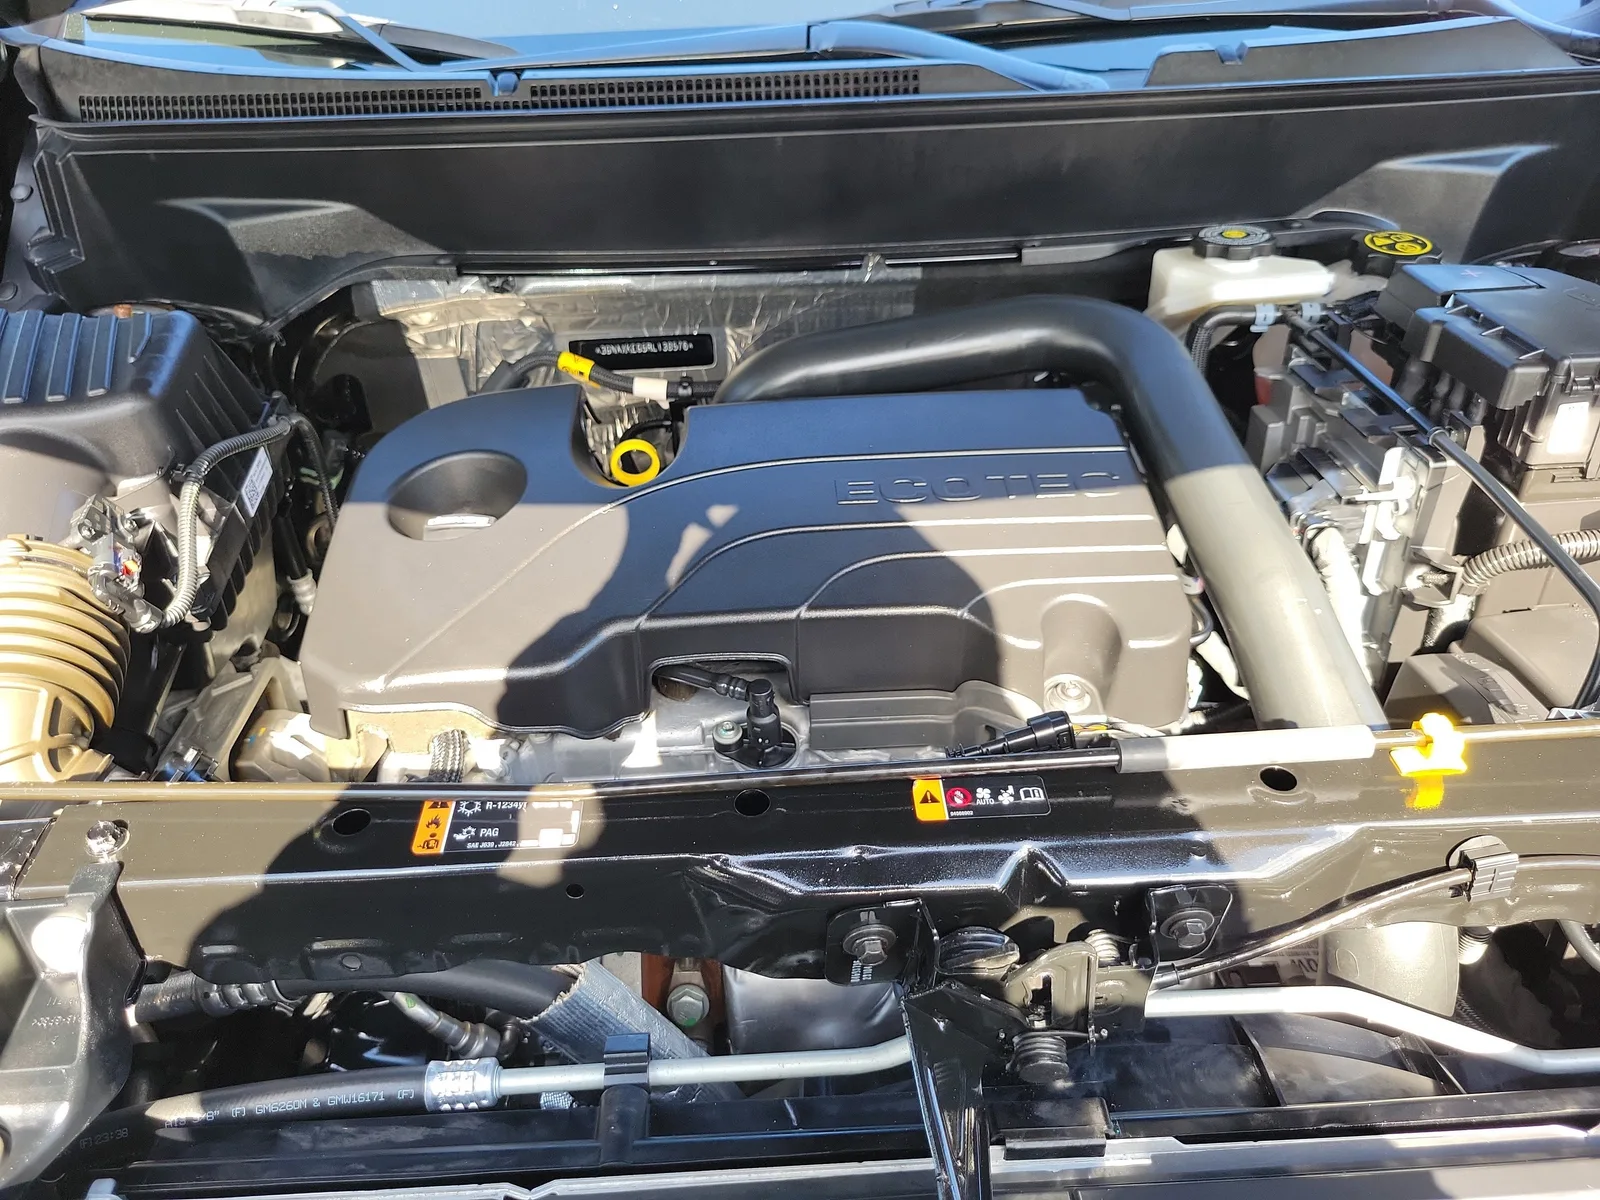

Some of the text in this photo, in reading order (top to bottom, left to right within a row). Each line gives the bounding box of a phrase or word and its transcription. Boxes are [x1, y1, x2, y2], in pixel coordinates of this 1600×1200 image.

[834, 473, 1120, 505] ECOTEC
[479, 828, 499, 837] PAG
[255, 1099, 307, 1115] GM6260M
[312, 1097, 321, 1108] &
[327, 1090, 385, 1106] GMW16171
